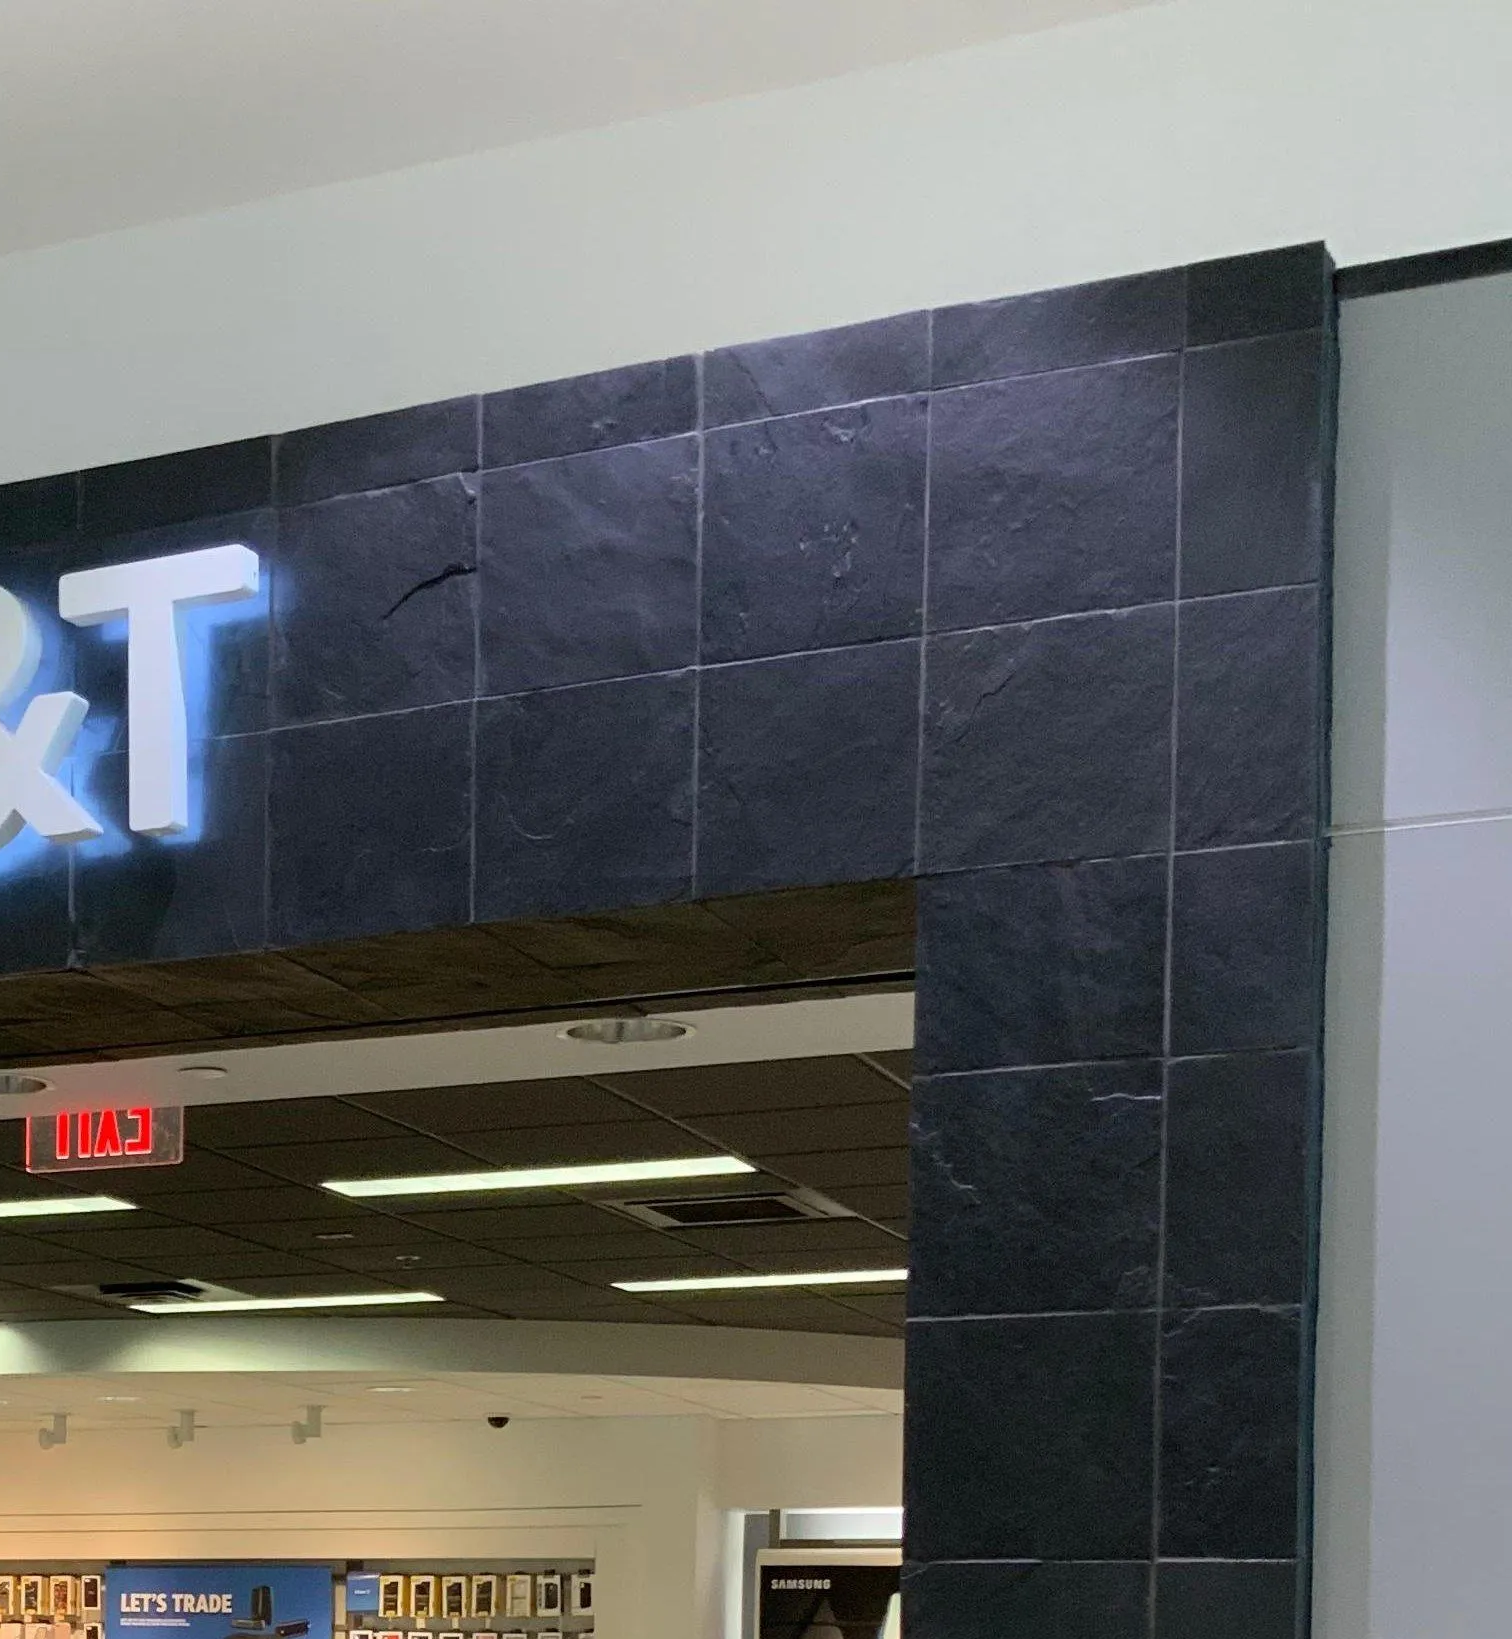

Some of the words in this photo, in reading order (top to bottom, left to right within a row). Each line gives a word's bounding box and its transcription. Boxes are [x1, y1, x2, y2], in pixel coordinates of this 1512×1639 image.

[771, 1579, 831, 1590] SAMSUNG
[120, 1593, 168, 1613] LET'S
[171, 1593, 233, 1613] TRADE
